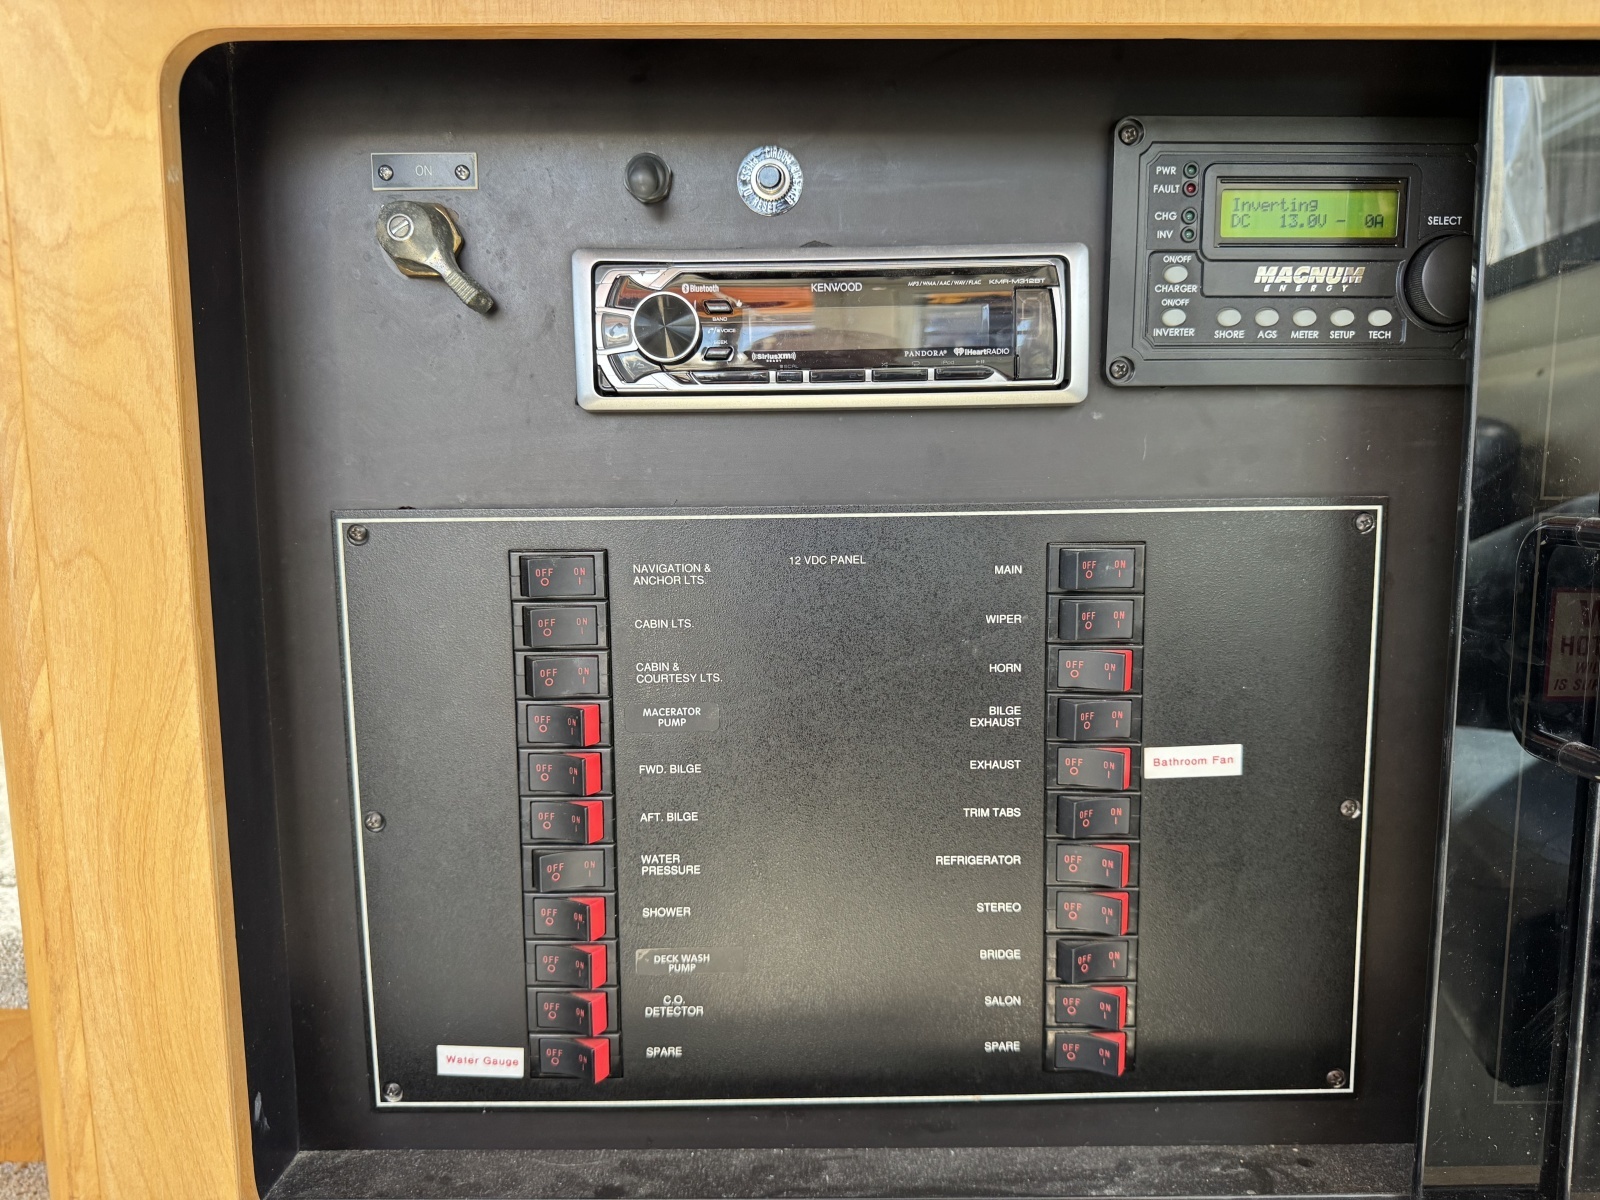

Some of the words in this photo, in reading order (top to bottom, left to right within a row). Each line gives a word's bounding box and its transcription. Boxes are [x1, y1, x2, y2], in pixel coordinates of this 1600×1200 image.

[416, 165, 432, 176] ON
[1157, 166, 1176, 174] PWR
[1154, 185, 1180, 193] FAULT
[752, 197, 778, 213] RESET
[1233, 198, 1318, 211] Inverting
[1155, 212, 1177, 220] CHG
[1231, 214, 1250, 227] DC
[1280, 214, 1327, 227] 13.0V
[1428, 216, 1462, 225] SELECT
[1157, 230, 1173, 238] INV
[1163, 255, 1191, 263] ON/OFF
[1254, 266, 1365, 284] MAGNUM
[690, 285, 719, 293] Bluetooth
[811, 282, 862, 292] KENWOOD
[1154, 328, 1195, 336] INVERTER
[1214, 330, 1244, 338] SHORE
[1257, 330, 1277, 338] AGS
[1369, 331, 1391, 339] TECH
[790, 556, 801, 565] 12
[804, 556, 827, 564] VDC
[831, 555, 866, 564] PANEL
[1082, 561, 1096, 569] OFF
[1114, 560, 1126, 568] ON
[536, 569, 553, 577] OFF
[574, 568, 586, 576] ON
[633, 564, 700, 573] NAVIGATION
[704, 564, 711, 572] &
[995, 565, 1022, 574] MAIN
[634, 576, 681, 585] ANCHOR
[685, 576, 707, 585] LTS.
[986, 615, 1021, 623] WIPER
[1082, 612, 1096, 620] OFF
[1114, 611, 1125, 619] ON
[538, 619, 556, 627] OFF
[577, 618, 588, 626] ON
[635, 620, 668, 628] CABIN
[671, 619, 694, 628] LTS.
[636, 663, 669, 671] CABIN
[673, 663, 679, 671] &
[990, 664, 1021, 672] HORN
[1066, 661, 1084, 669] OFF
[1105, 663, 1115, 671] ON
[540, 669, 557, 677] OFF
[637, 674, 697, 683] COURTESY
[700, 674, 722, 683] LTS.
[643, 707, 700, 716] MACERATOR
[989, 706, 1021, 715] BILGE
[1081, 712, 1094, 721] OFF
[1112, 711, 1123, 719] ON
[568, 718, 577, 726] ON
[658, 718, 686, 726] PUMP
[970, 718, 1021, 727] EXHAUST
[970, 760, 1021, 769] EXHAUST
[1065, 758, 1083, 766] OFF
[1104, 762, 1114, 770] ON
[1154, 758, 1207, 766] Bathroom
[1213, 756, 1234, 764] Fan
[536, 764, 553, 772] OFF
[569, 767, 577, 775] ON
[639, 765, 667, 774] FWD.
[670, 764, 701, 773] BILGE
[640, 813, 663, 822] AFT.
[667, 812, 698, 821] BILGE
[963, 808, 989, 817] TRIM
[993, 808, 1021, 817] TABS
[1079, 810, 1093, 819] OFF
[1111, 808, 1122, 816] ON
[572, 815, 580, 823] ON
[641, 854, 680, 864] WATER
[936, 855, 1021, 865] REFRIGERATOR
[1064, 856, 1082, 864] OFF
[1102, 860, 1114, 868] ON
[547, 863, 564, 872] OFF
[642, 865, 700, 875] PRESSURE
[977, 903, 1021, 912] STEREO
[1064, 903, 1082, 911] OFF
[1102, 907, 1113, 916] ON
[541, 909, 557, 917] OFF
[574, 913, 583, 921] ON
[643, 907, 690, 918] SHOWER
[654, 955, 678, 963] DECK
[681, 954, 710, 962] WASH
[980, 949, 1020, 959] BRIDGE
[1078, 954, 1091, 964] OFF
[1109, 952, 1120, 960] ON
[543, 956, 559, 964] OFF
[576, 961, 584, 969] ON
[669, 964, 696, 972] PUMP
[663, 995, 685, 1005] C.O.
[985, 996, 1021, 1006] SALON
[1063, 998, 1080, 1006] OFF
[1100, 1002, 1111, 1012] ON
[576, 1008, 584, 1016] ON
[645, 1006, 703, 1017] DETECTOR
[985, 1041, 1020, 1052] SPARE
[1063, 1043, 1079, 1051] OFF
[1099, 1048, 1110, 1058] ON
[546, 1049, 563, 1057] OFF
[579, 1055, 587, 1063] ON
[647, 1047, 682, 1057] SPARE
[446, 1055, 479, 1063] Water
[483, 1057, 518, 1066] Gauge
